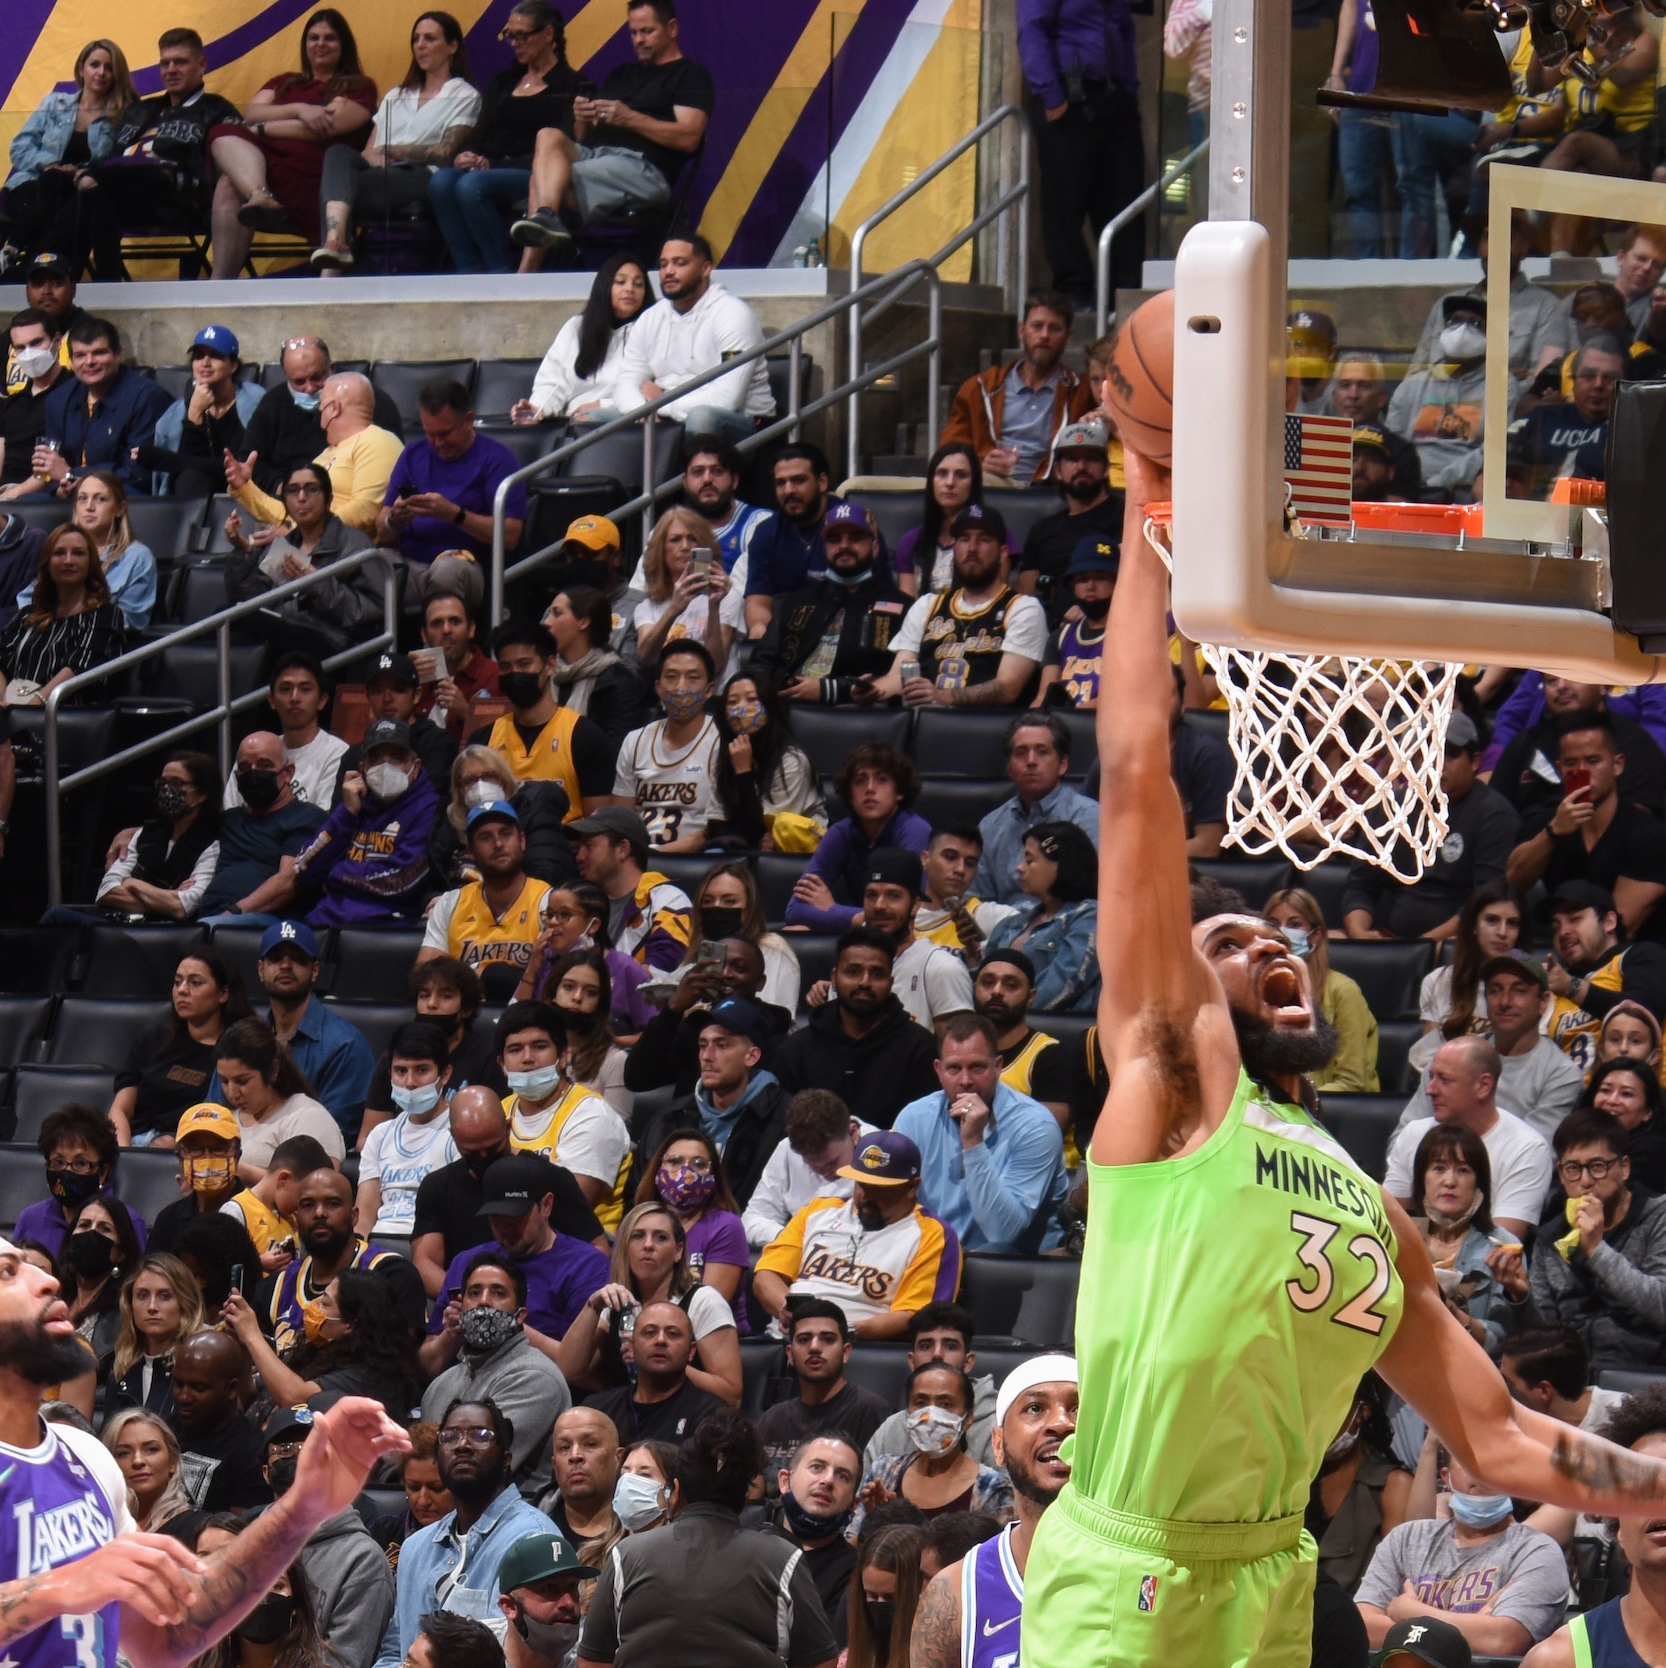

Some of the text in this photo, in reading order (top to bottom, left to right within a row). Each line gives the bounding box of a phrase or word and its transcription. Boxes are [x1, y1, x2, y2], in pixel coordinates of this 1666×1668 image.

[1550, 427, 1601, 448] UCLA
[925, 615, 954, 640] Los
[935, 629, 1003, 658] Angeles
[380, 655, 392, 668] LA
[935, 657, 969, 689] 8
[634, 783, 696, 806] LAKERS
[280, 921, 296, 938] LA
[459, 940, 533, 970] LAKERS
[1569, 1032, 1594, 1070] 8
[381, 1163, 432, 1188] LAKERS
[800, 1243, 894, 1300] LAKERS
[1286, 1210, 1390, 1336] 32
[12, 1492, 114, 1579] LAKERS
[552, 1542, 562, 1562] P
